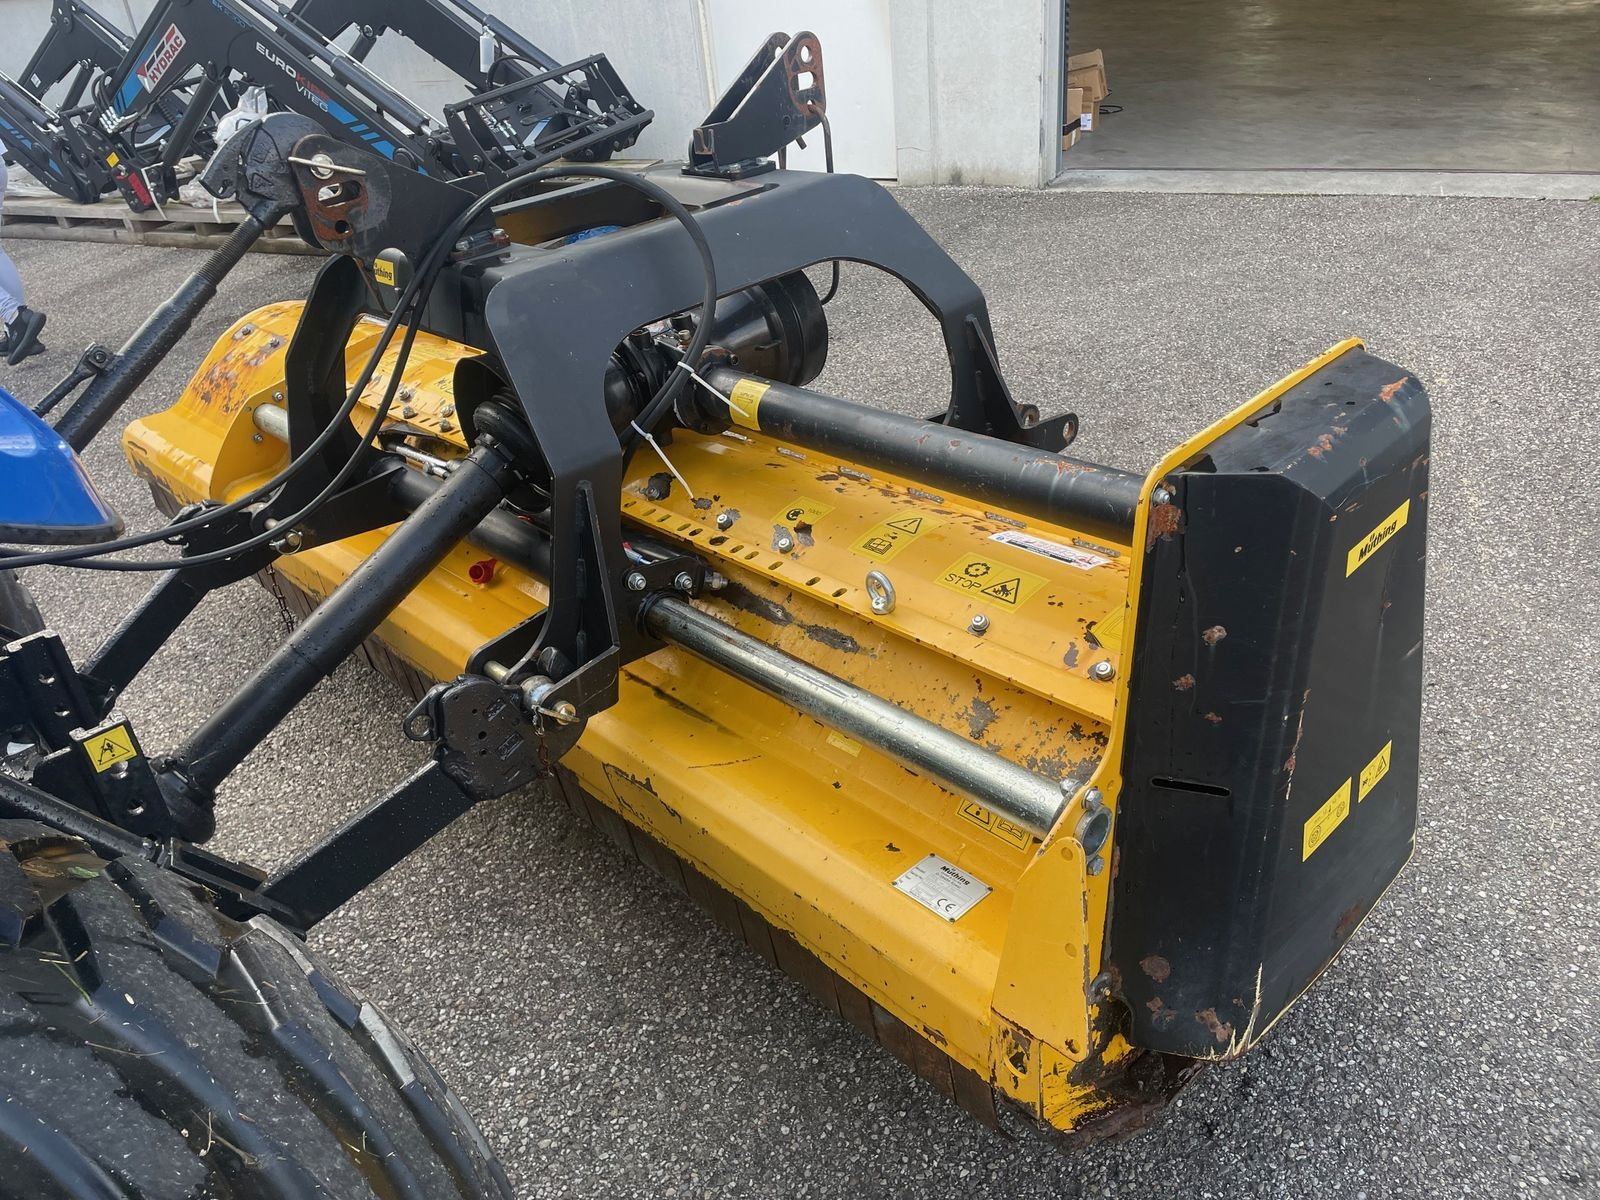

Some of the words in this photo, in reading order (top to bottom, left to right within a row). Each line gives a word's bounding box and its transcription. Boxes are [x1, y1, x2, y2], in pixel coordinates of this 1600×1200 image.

[149, 35, 183, 84] HYDRAC
[375, 263, 393, 281] üthing
[1358, 519, 1397, 562] Müthing
[944, 573, 982, 590] STOP
[940, 865, 971, 887] Müthing
